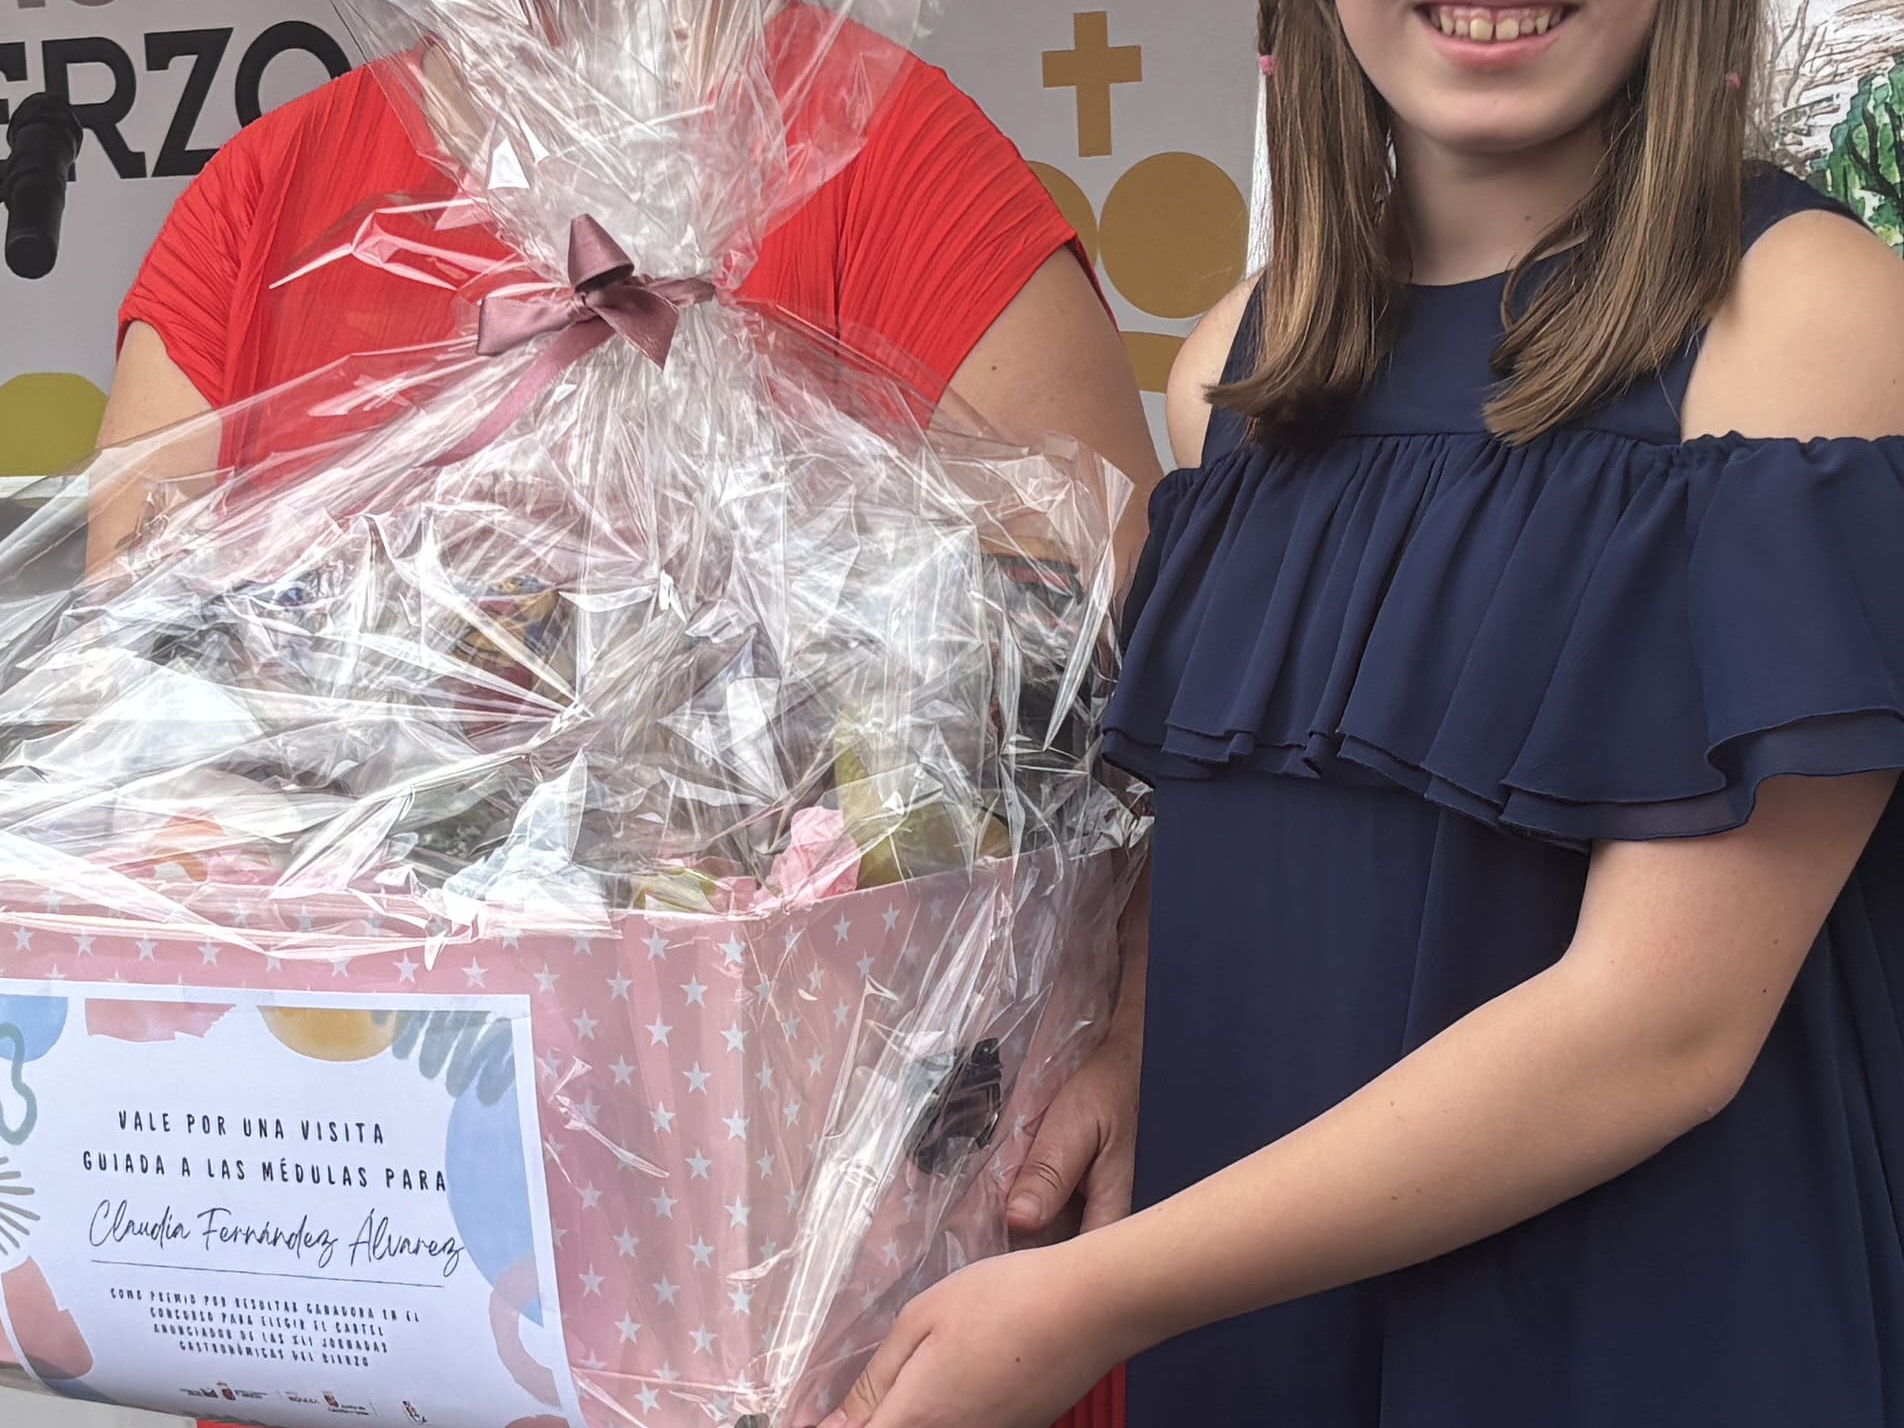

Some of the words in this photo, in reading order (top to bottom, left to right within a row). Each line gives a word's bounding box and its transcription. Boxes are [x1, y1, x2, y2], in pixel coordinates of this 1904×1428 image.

[118, 1110, 171, 1133] VALE
[186, 1113, 227, 1136] POR
[243, 1118, 285, 1140] UNA
[301, 1120, 384, 1145] VISITA
[83, 1150, 165, 1176] GUIADA
[181, 1156, 192, 1177] A
[207, 1158, 246, 1181] LAS
[262, 1157, 369, 1188] MÉDULAS
[385, 1168, 446, 1192] PARA
[89, 1199, 191, 1250] Claudia
[196, 1206, 338, 1268] Fernández
[348, 1208, 465, 1278] Álvarez
